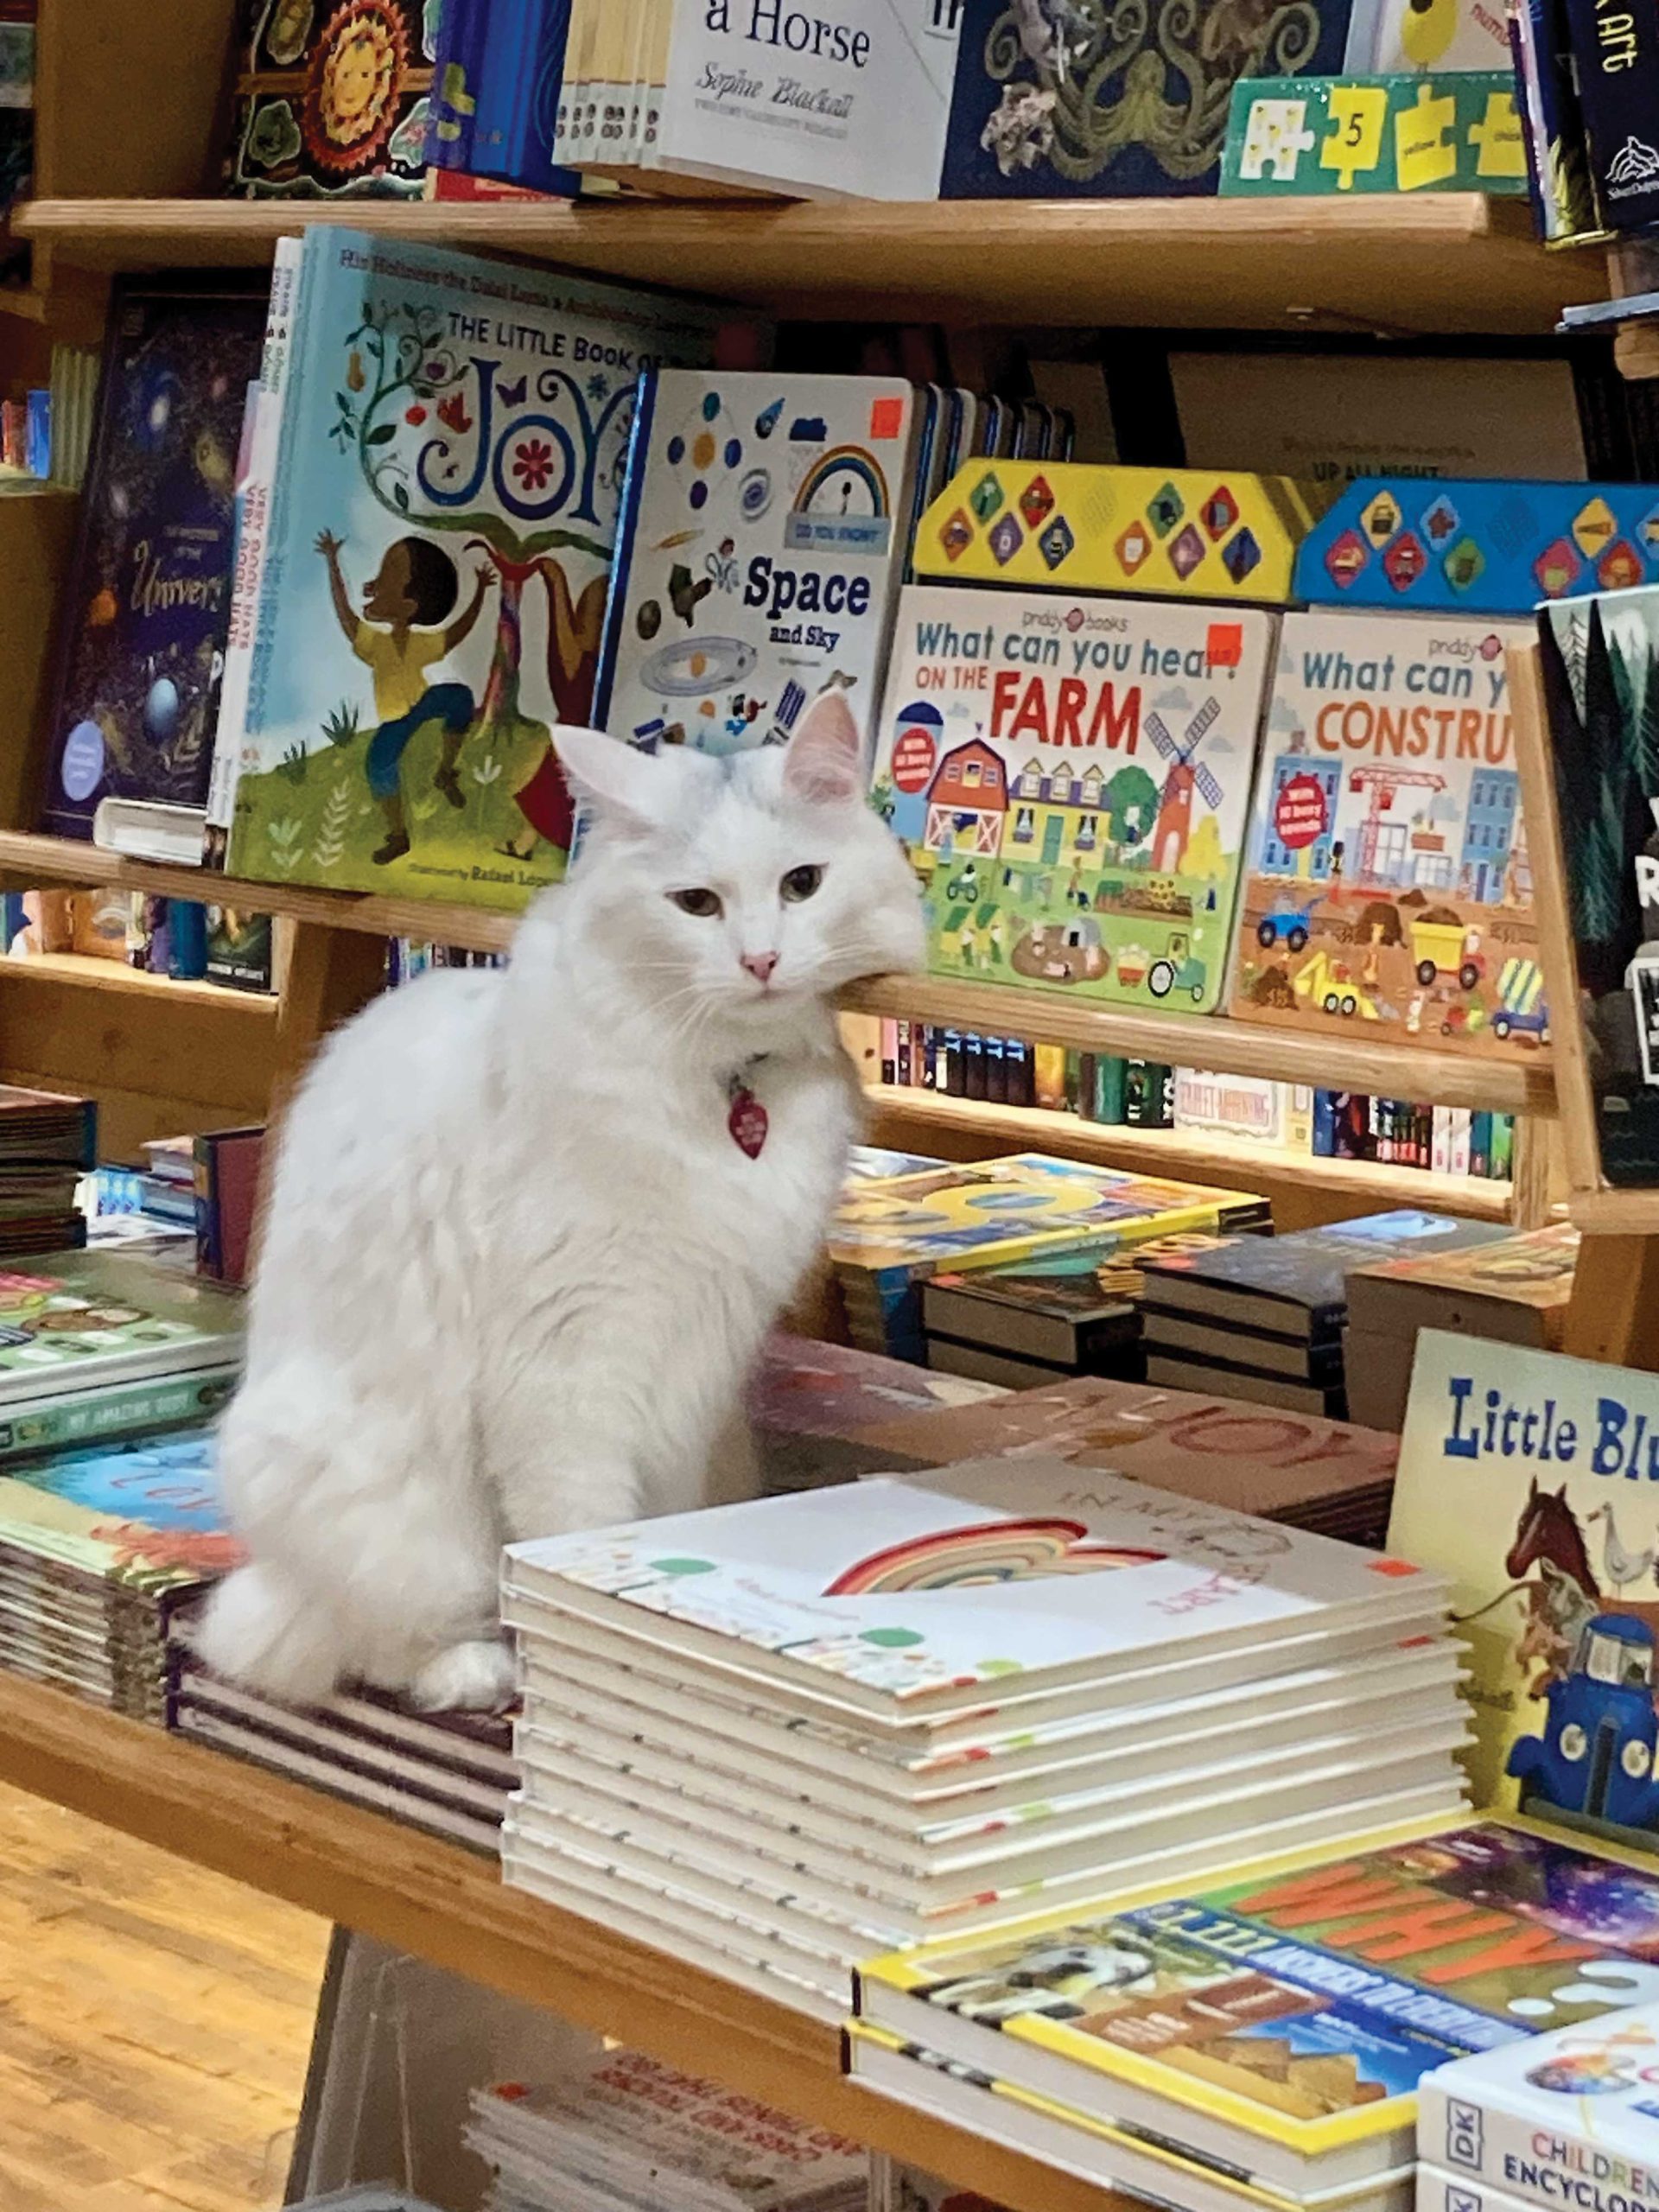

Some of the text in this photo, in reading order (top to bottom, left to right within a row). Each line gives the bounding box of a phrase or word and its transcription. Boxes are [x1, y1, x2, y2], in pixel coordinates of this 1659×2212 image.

[705, 0, 871, 68] a Horse
[696, 61, 763, 100] Sophie
[1347, 112, 1363, 147] 5
[448, 312, 491, 346] THE
[496, 323, 566, 358] LITTLE
[574, 337, 633, 371] BOOK
[416, 356, 639, 525] JOY
[743, 555, 872, 620] Space
[769, 624, 842, 653] and Sky
[916, 621, 995, 660] What
[1003, 632, 1060, 667] can
[1072, 638, 1133, 676] you
[1084, 611, 1128, 633] books
[1303, 651, 1395, 691] What
[1405, 661, 1474, 699] can
[915, 664, 1143, 756] ON THE FARM
[1315, 701, 1515, 765] CONSTRU
[1444, 1376, 1578, 1461] Little
[1454, 2107, 1475, 2159] DK
